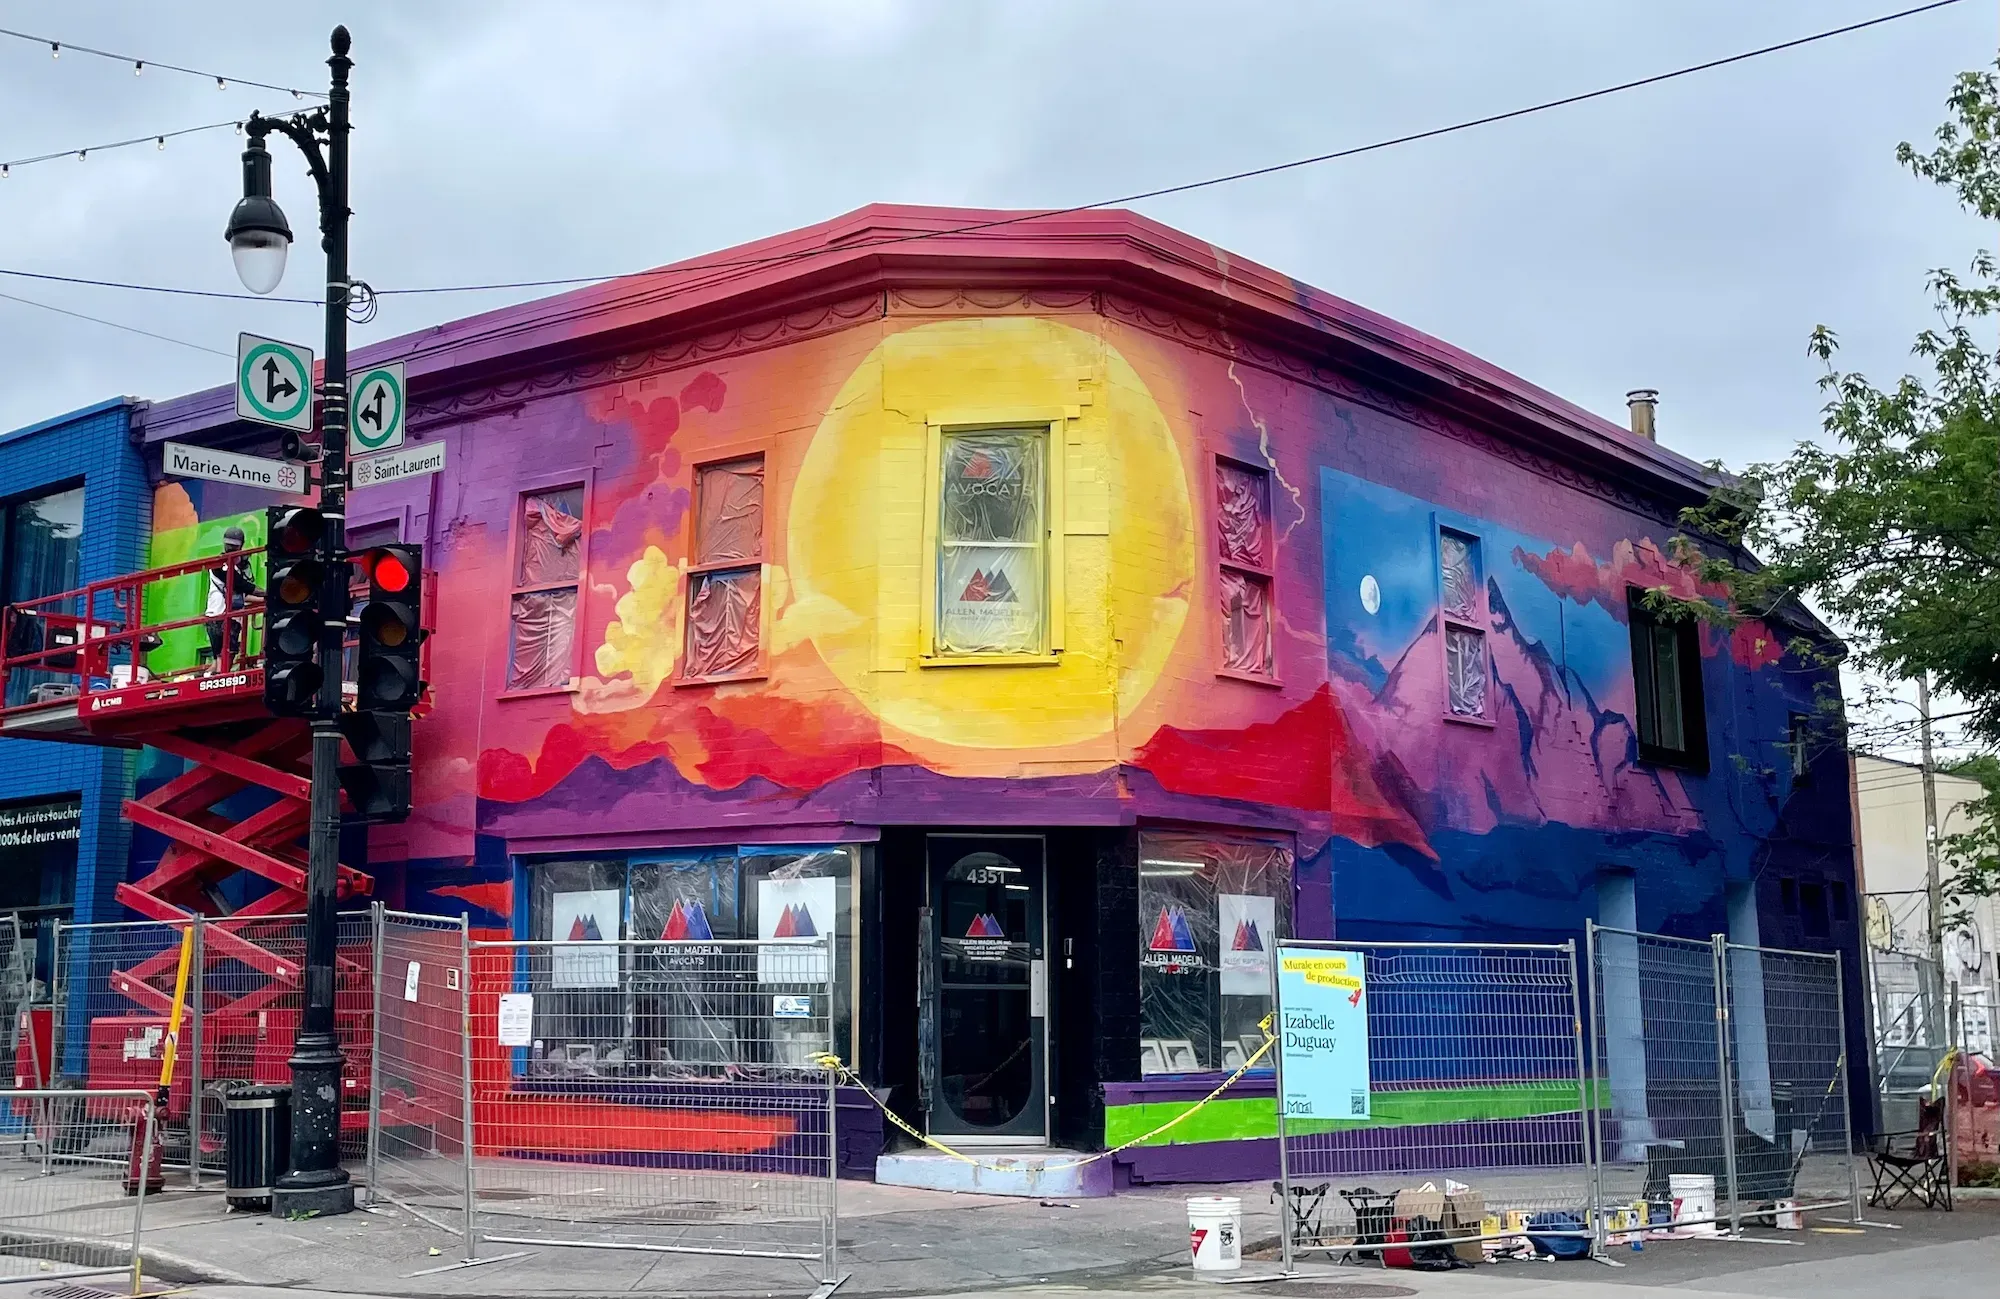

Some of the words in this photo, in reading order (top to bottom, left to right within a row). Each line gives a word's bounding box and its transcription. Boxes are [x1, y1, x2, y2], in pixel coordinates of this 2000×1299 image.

[173, 454, 271, 483] Marie-Anne
[374, 454, 440, 480] Saint-Laurent
[947, 482, 1034, 497] AVOCATS
[945, 607, 976, 617] ALLEN
[16, 811, 50, 826] Artistes
[21, 829, 33, 844] de
[33, 828, 55, 843] leurs
[967, 868, 1005, 885] 4351
[653, 945, 680, 955] ALLEN
[684, 945, 722, 955] MADELIN
[669, 957, 705, 966] AVOCATS
[1144, 953, 1169, 964] ALLEN
[1171, 954, 1203, 966] MADELIN
[1284, 960, 1312, 970] Murale
[1313, 962, 1324, 970] en
[1324, 962, 1346, 970] cours
[1306, 970, 1316, 981] de
[1317, 974, 1360, 988] production
[1284, 1012, 1335, 1031] Izabelle
[1285, 1031, 1337, 1053] Duguay
